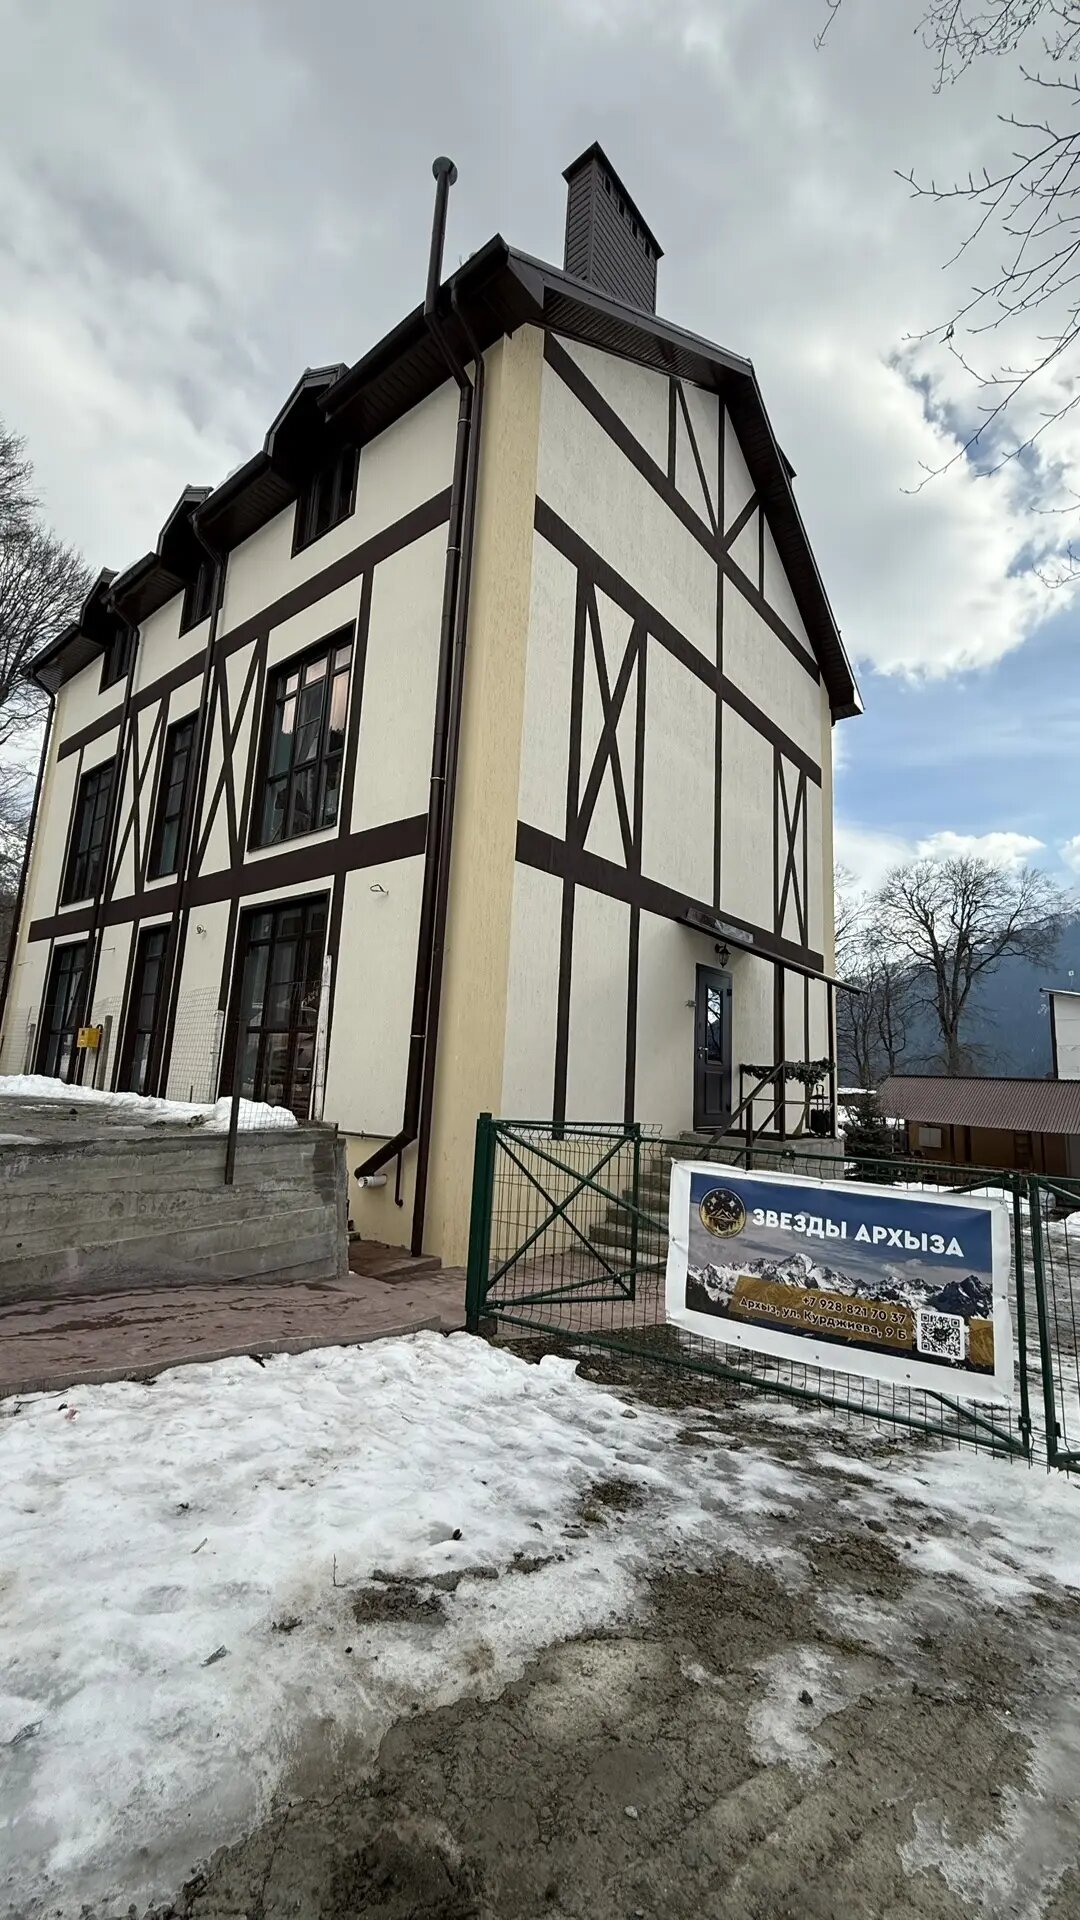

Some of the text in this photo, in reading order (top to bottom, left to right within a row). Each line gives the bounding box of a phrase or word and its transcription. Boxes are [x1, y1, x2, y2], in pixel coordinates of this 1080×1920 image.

[751, 1208, 965, 1258] ЗВЕЗДЫ АРХЫЗА
[739, 1296, 907, 1340] Архыз, ул. Курджиева, 9 Б
[802, 1297, 906, 1324] +7 928 821 70 37
